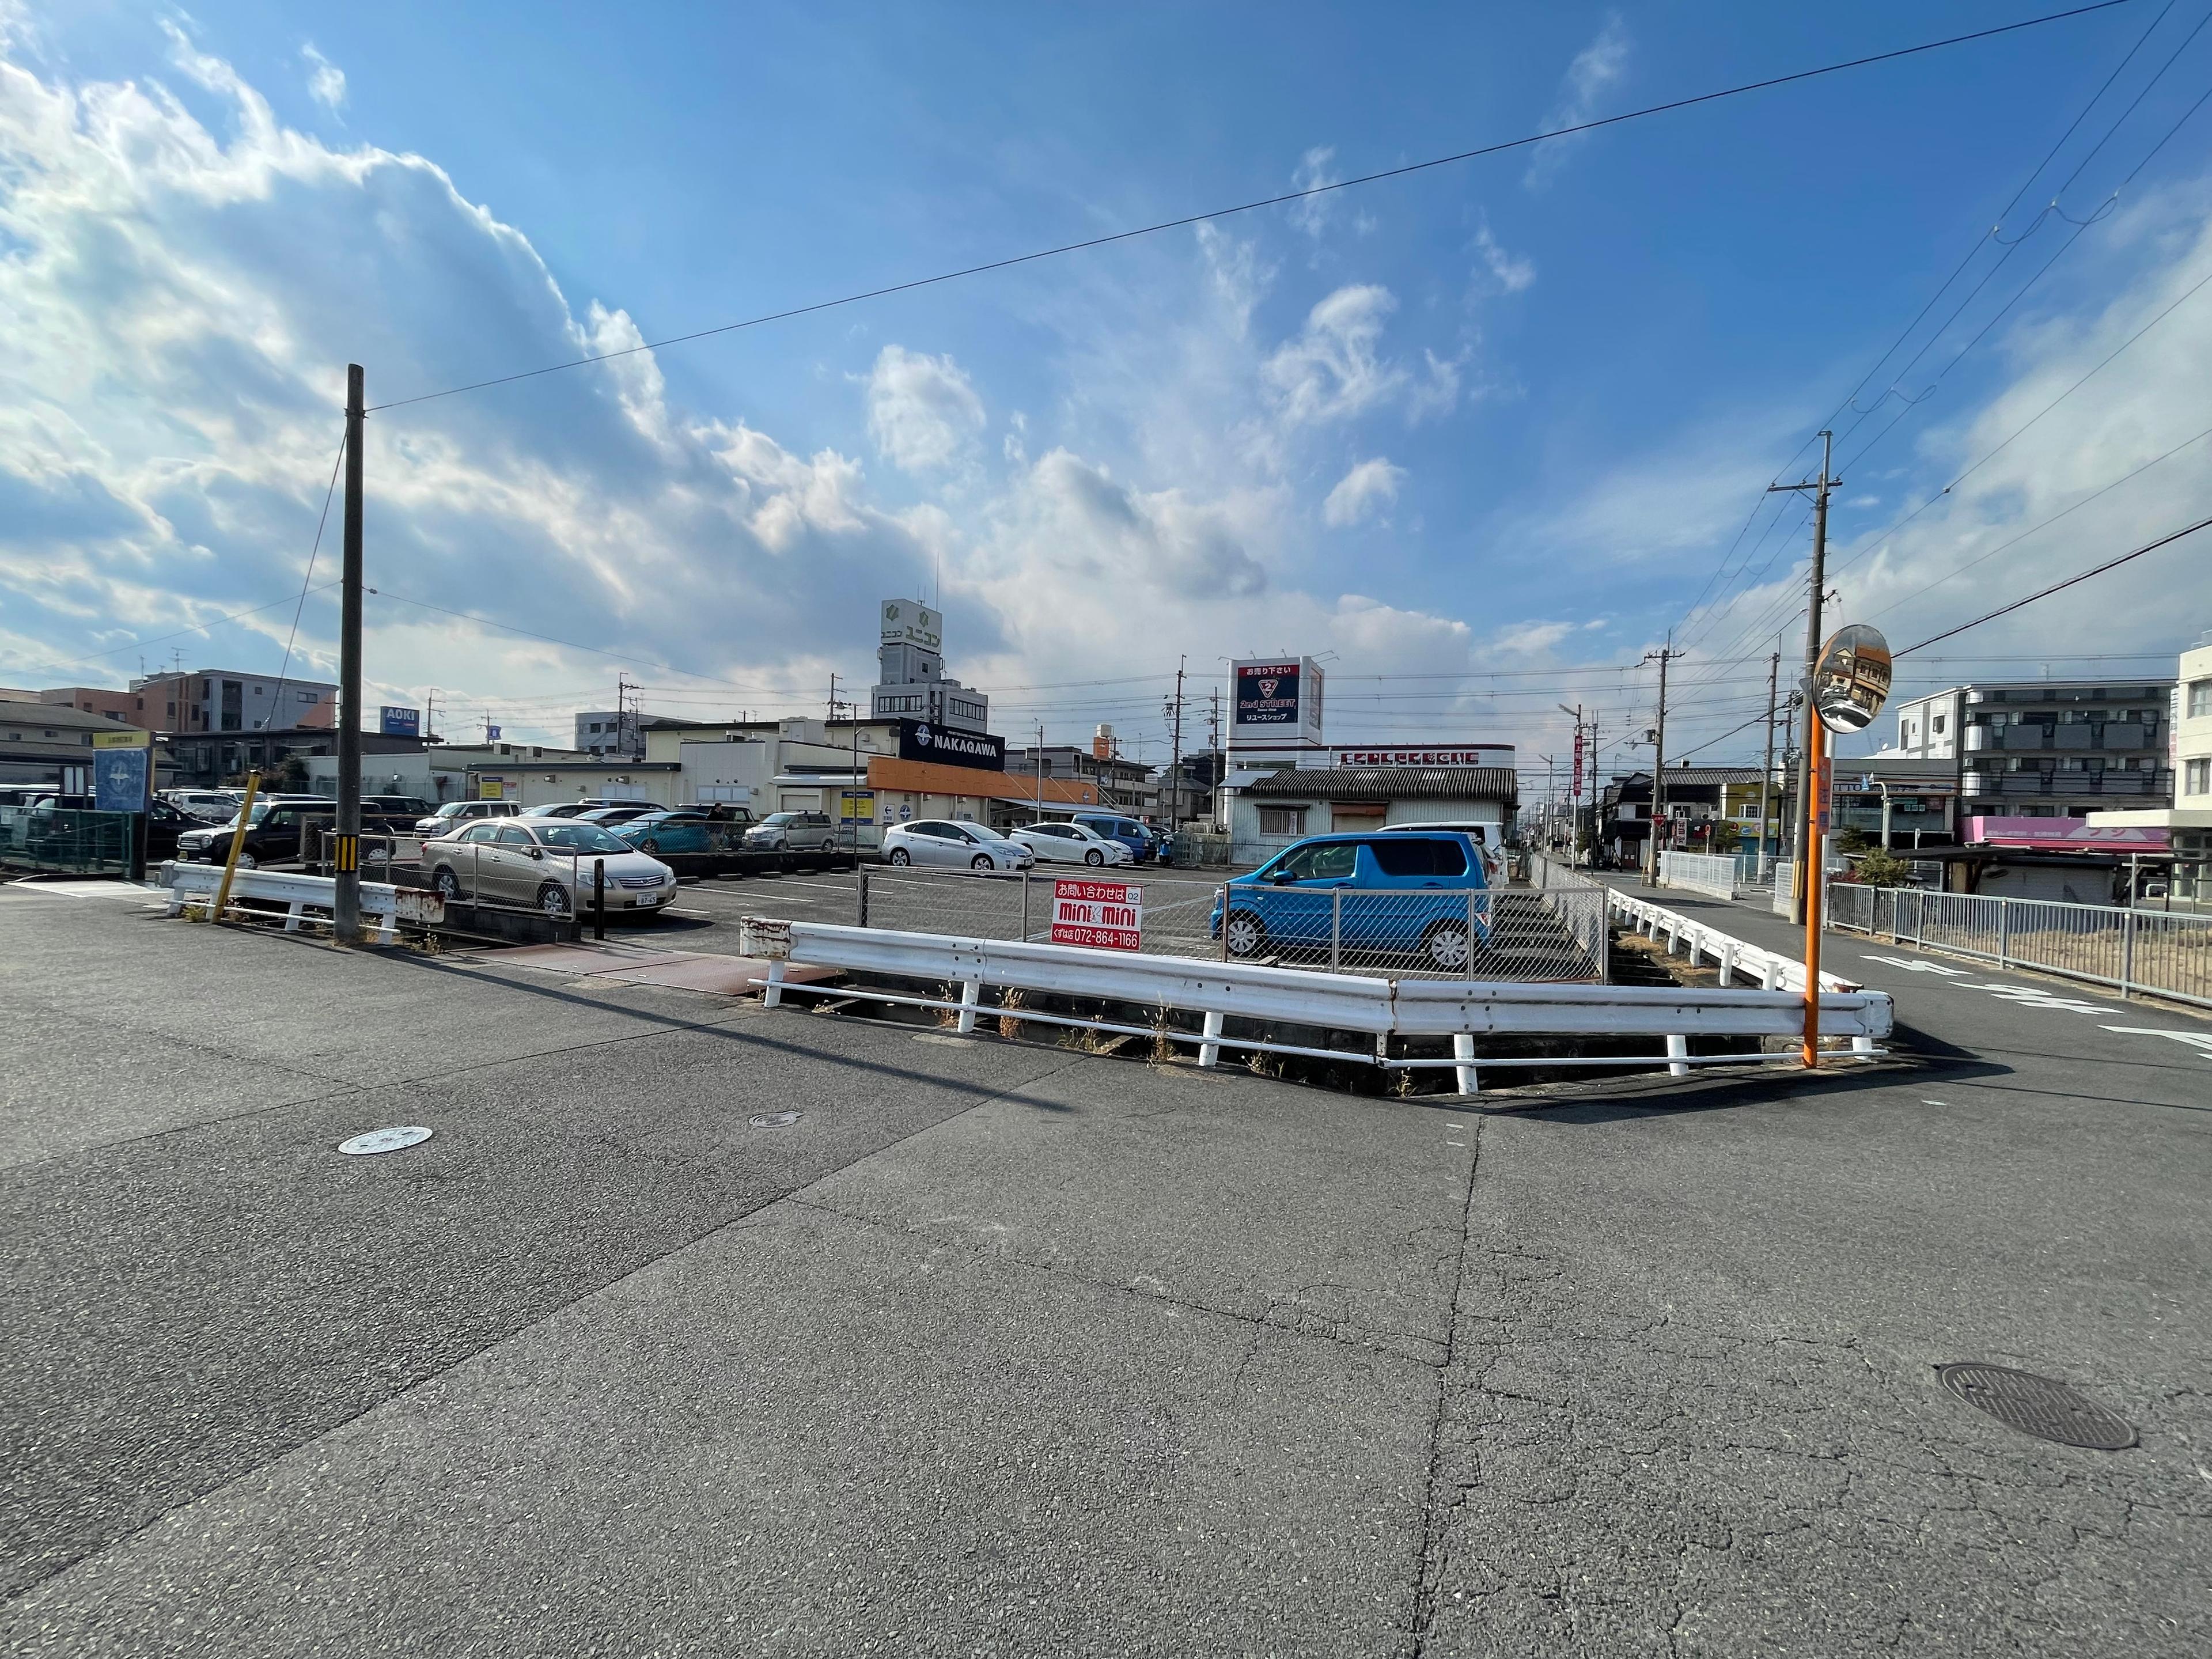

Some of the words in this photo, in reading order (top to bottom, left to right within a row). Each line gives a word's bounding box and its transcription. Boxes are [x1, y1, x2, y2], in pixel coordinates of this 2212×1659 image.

[881, 630, 903, 638] ユニコン
[906, 626, 941, 648] ユニコン
[1247, 666, 1291, 675] お売り下さい
[1240, 700, 1258, 709] 2nd
[1260, 699, 1296, 708] STREET
[386, 709, 415, 721] AOKI
[934, 734, 997, 757] NAKAGAWA
[1058, 883, 1124, 901] お問い合わせは
[1059, 902, 1092, 922] mini
[1102, 906, 1136, 927] mini
[1054, 928, 1074, 940] くずは店
[1074, 929, 1138, 948] 072-864-1166
